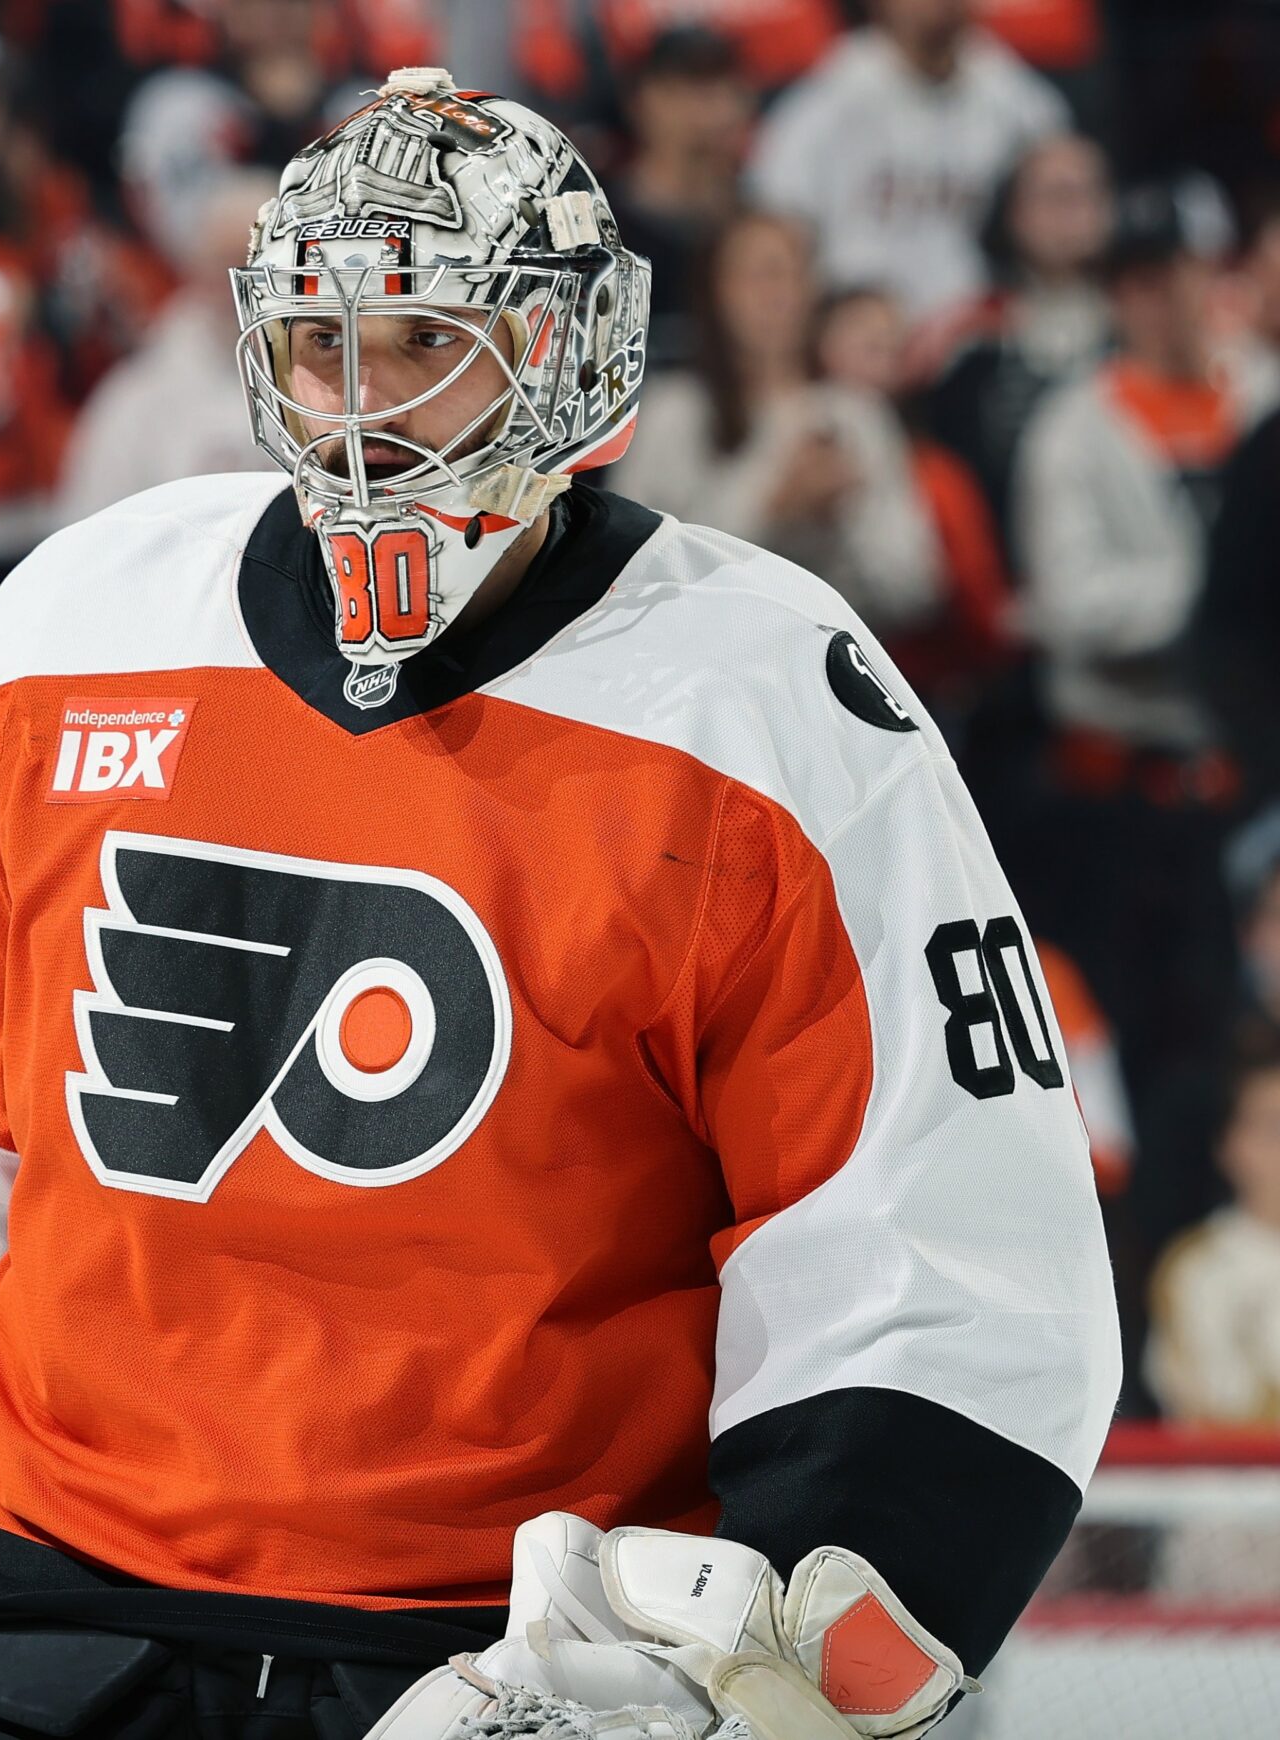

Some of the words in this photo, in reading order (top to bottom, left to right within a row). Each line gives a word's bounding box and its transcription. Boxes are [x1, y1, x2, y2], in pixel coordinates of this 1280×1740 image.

[297, 219, 411, 242] BAUER
[324, 522, 433, 647] 80
[355, 671, 390, 696] NHL
[64, 709, 166, 729] Independence
[52, 729, 180, 792] IBX
[924, 915, 1064, 1100] 80
[690, 1563, 713, 1598] VLADAR
